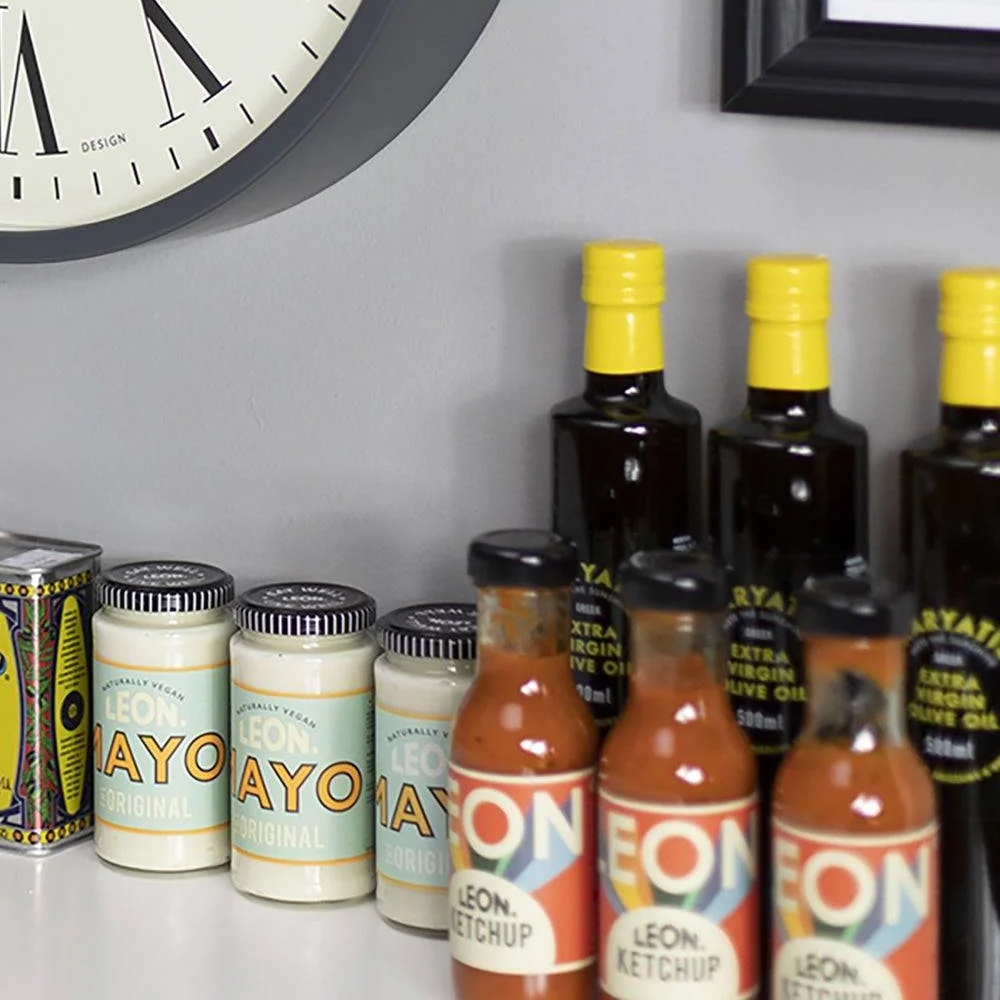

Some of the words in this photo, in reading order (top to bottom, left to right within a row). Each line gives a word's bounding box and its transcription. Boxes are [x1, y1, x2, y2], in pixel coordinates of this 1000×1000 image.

[80, 133, 128, 154] DESIGN
[570, 620, 618, 640] XTRA
[569, 638, 623, 657] IRGIN
[730, 642, 791, 666] EXTRA
[569, 655, 597, 674] IVE
[726, 660, 797, 684] VIRGIN
[101, 677, 149, 692] NATURALLY
[151, 681, 185, 702] VEGAN
[104, 690, 188, 728] LEON.
[235, 702, 280, 716] NATURALLY
[282, 707, 318, 729] VEGAN
[238, 715, 319, 755] LEON.
[387, 727, 439, 742] NATURALLY
[391, 741, 446, 779] LEO
[230, 746, 363, 814] AYO
[106, 787, 193, 819] ORIGINAL
[240, 816, 325, 849] ORIGINAL
[393, 844, 445, 876] ORIGI
[600, 811, 757, 895] EON
[459, 884, 518, 918] LEON.
[633, 921, 706, 952] LEON.
[616, 945, 721, 983] KETCHUP
